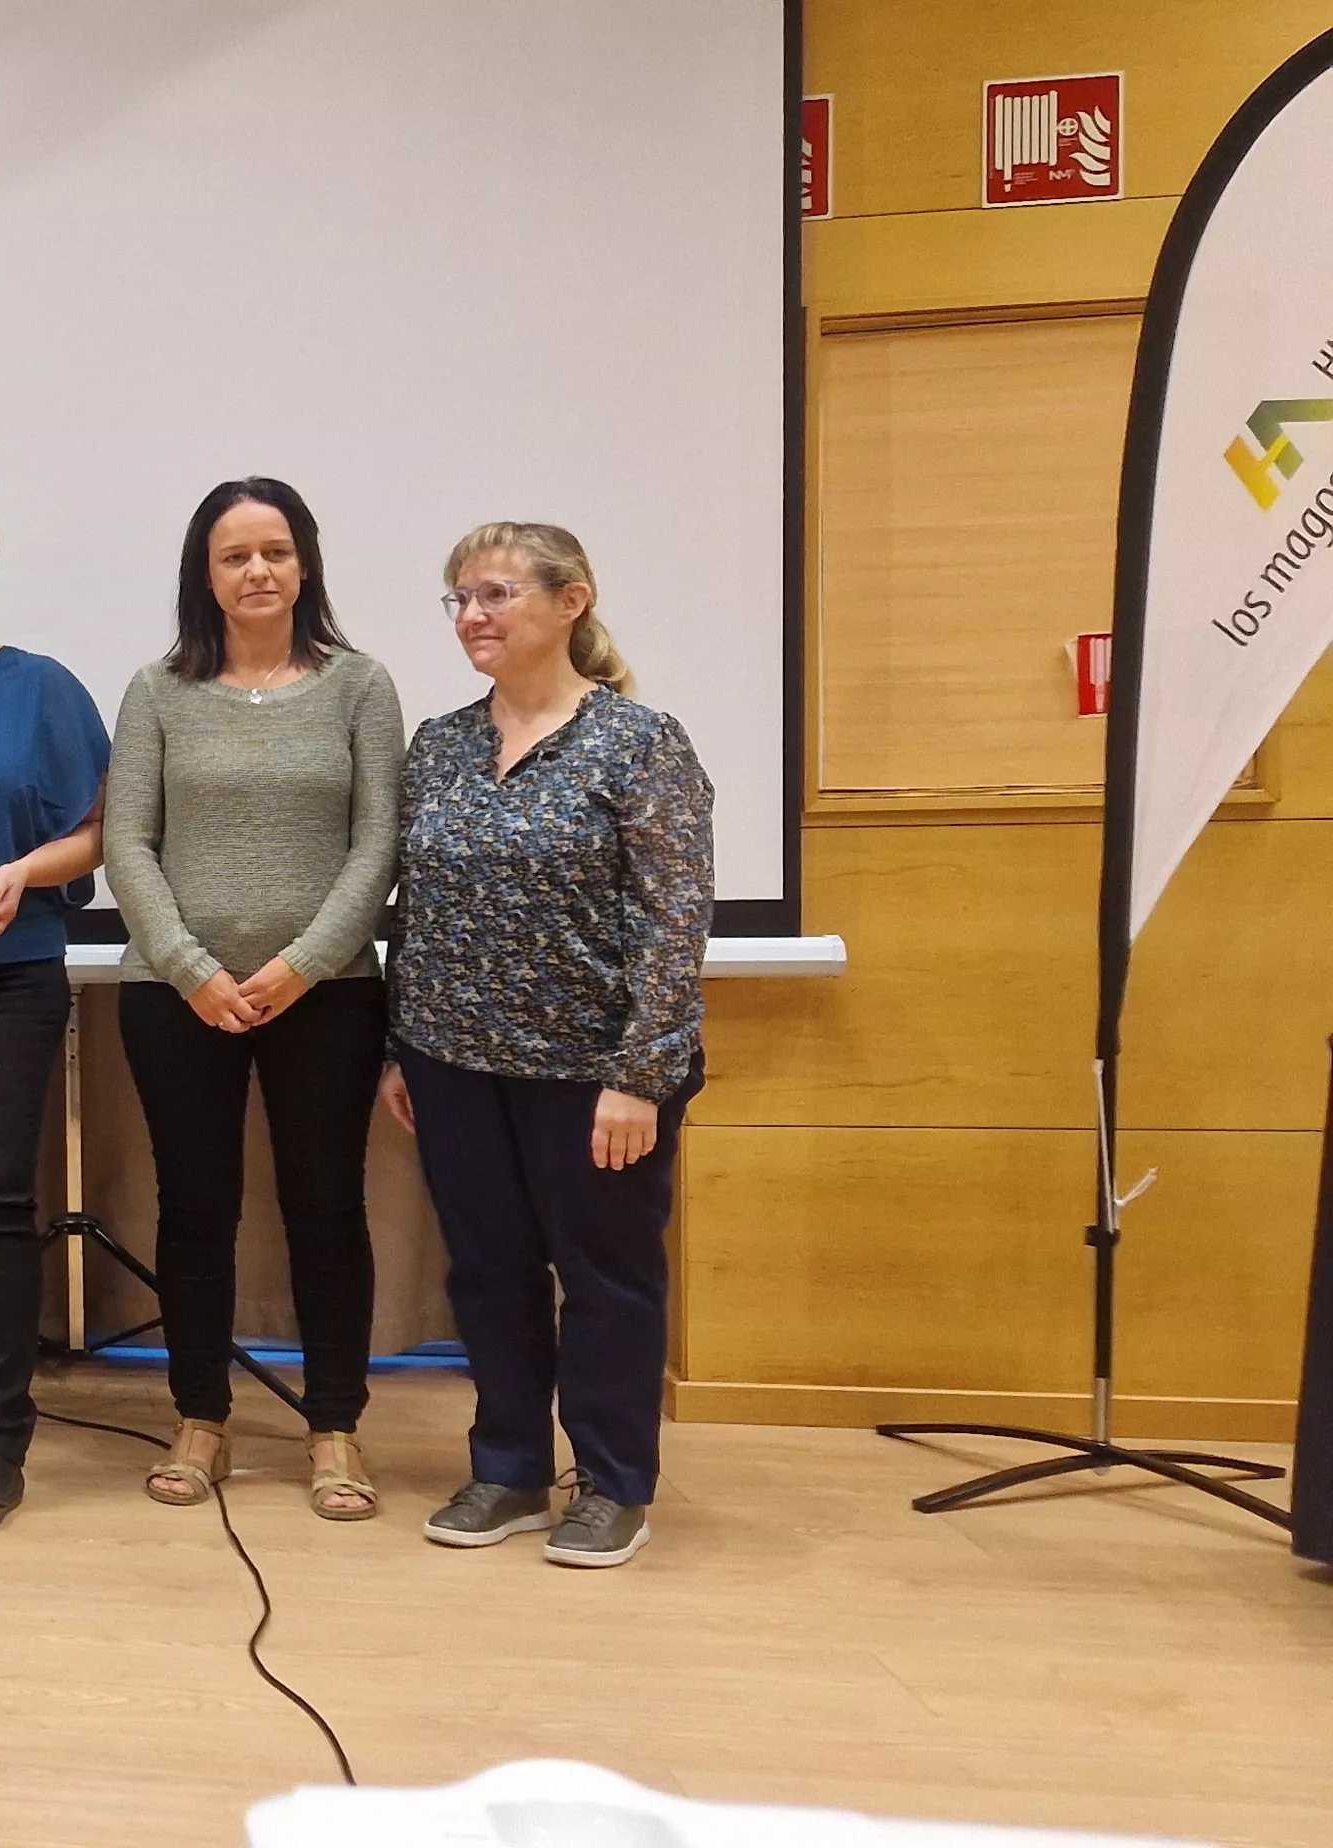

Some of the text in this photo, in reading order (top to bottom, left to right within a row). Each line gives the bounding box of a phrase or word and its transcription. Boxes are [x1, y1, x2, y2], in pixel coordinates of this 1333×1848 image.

[1312, 339, 1333, 380] H
[1212, 471, 1333, 646] los mago
